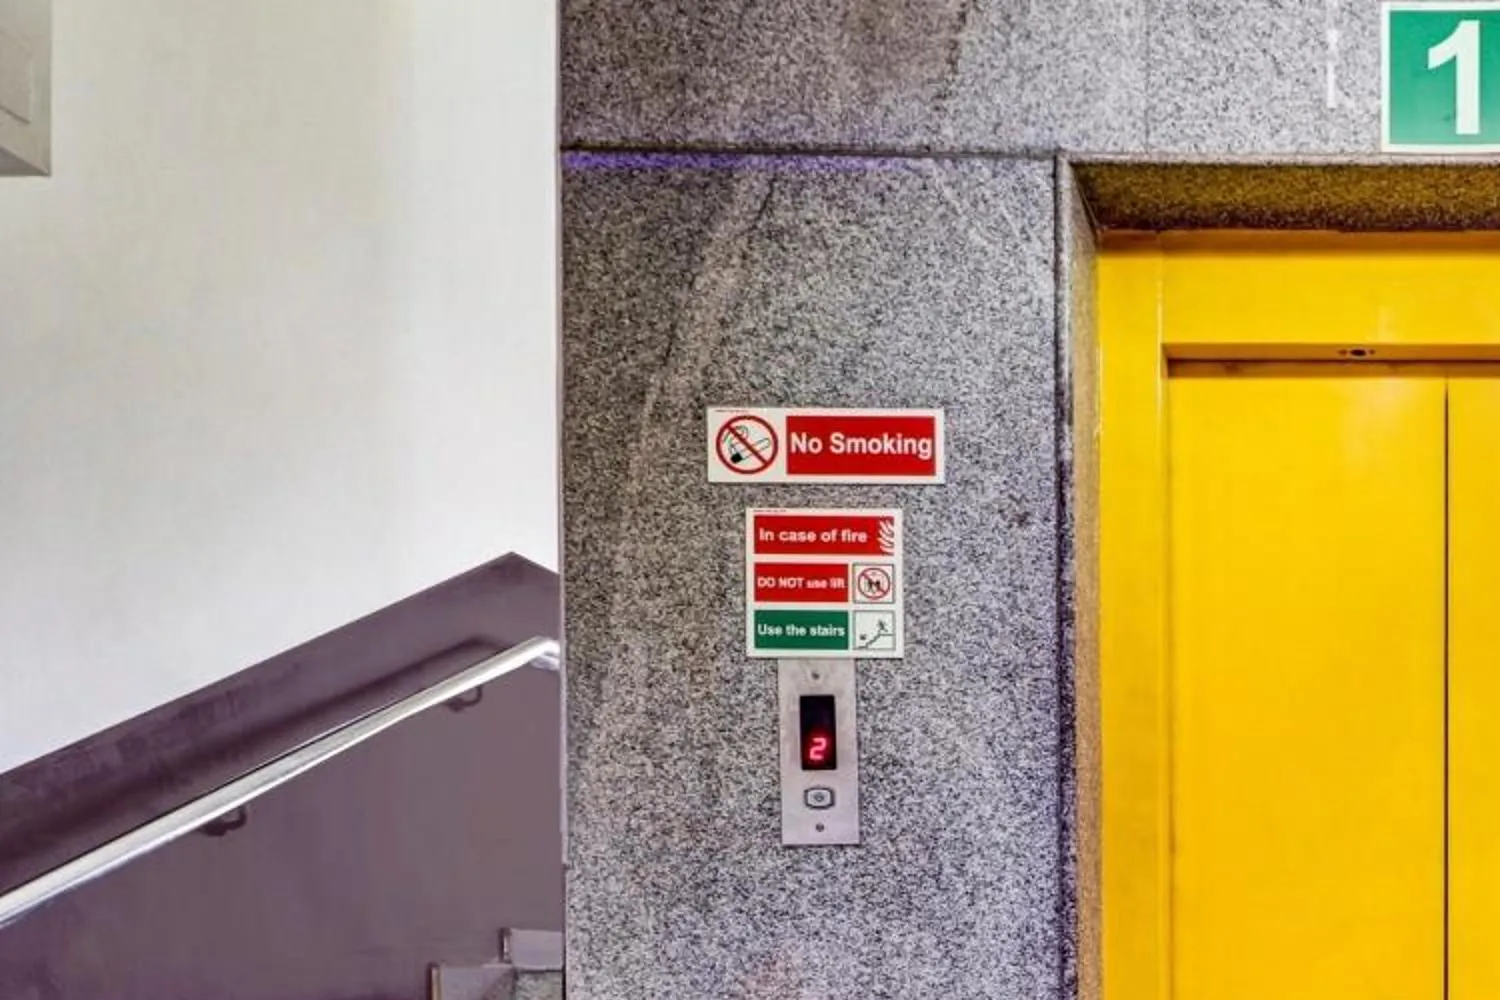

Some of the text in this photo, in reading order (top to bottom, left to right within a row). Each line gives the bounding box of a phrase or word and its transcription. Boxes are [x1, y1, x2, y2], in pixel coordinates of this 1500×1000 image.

[1427, 20, 1480, 135] 1
[790, 431, 933, 460] No Smoking
[759, 527, 868, 543] In case of fire
[757, 577, 846, 589] DO NOT use lift
[757, 623, 846, 637] Use the stairs
[808, 736, 828, 761] 2
